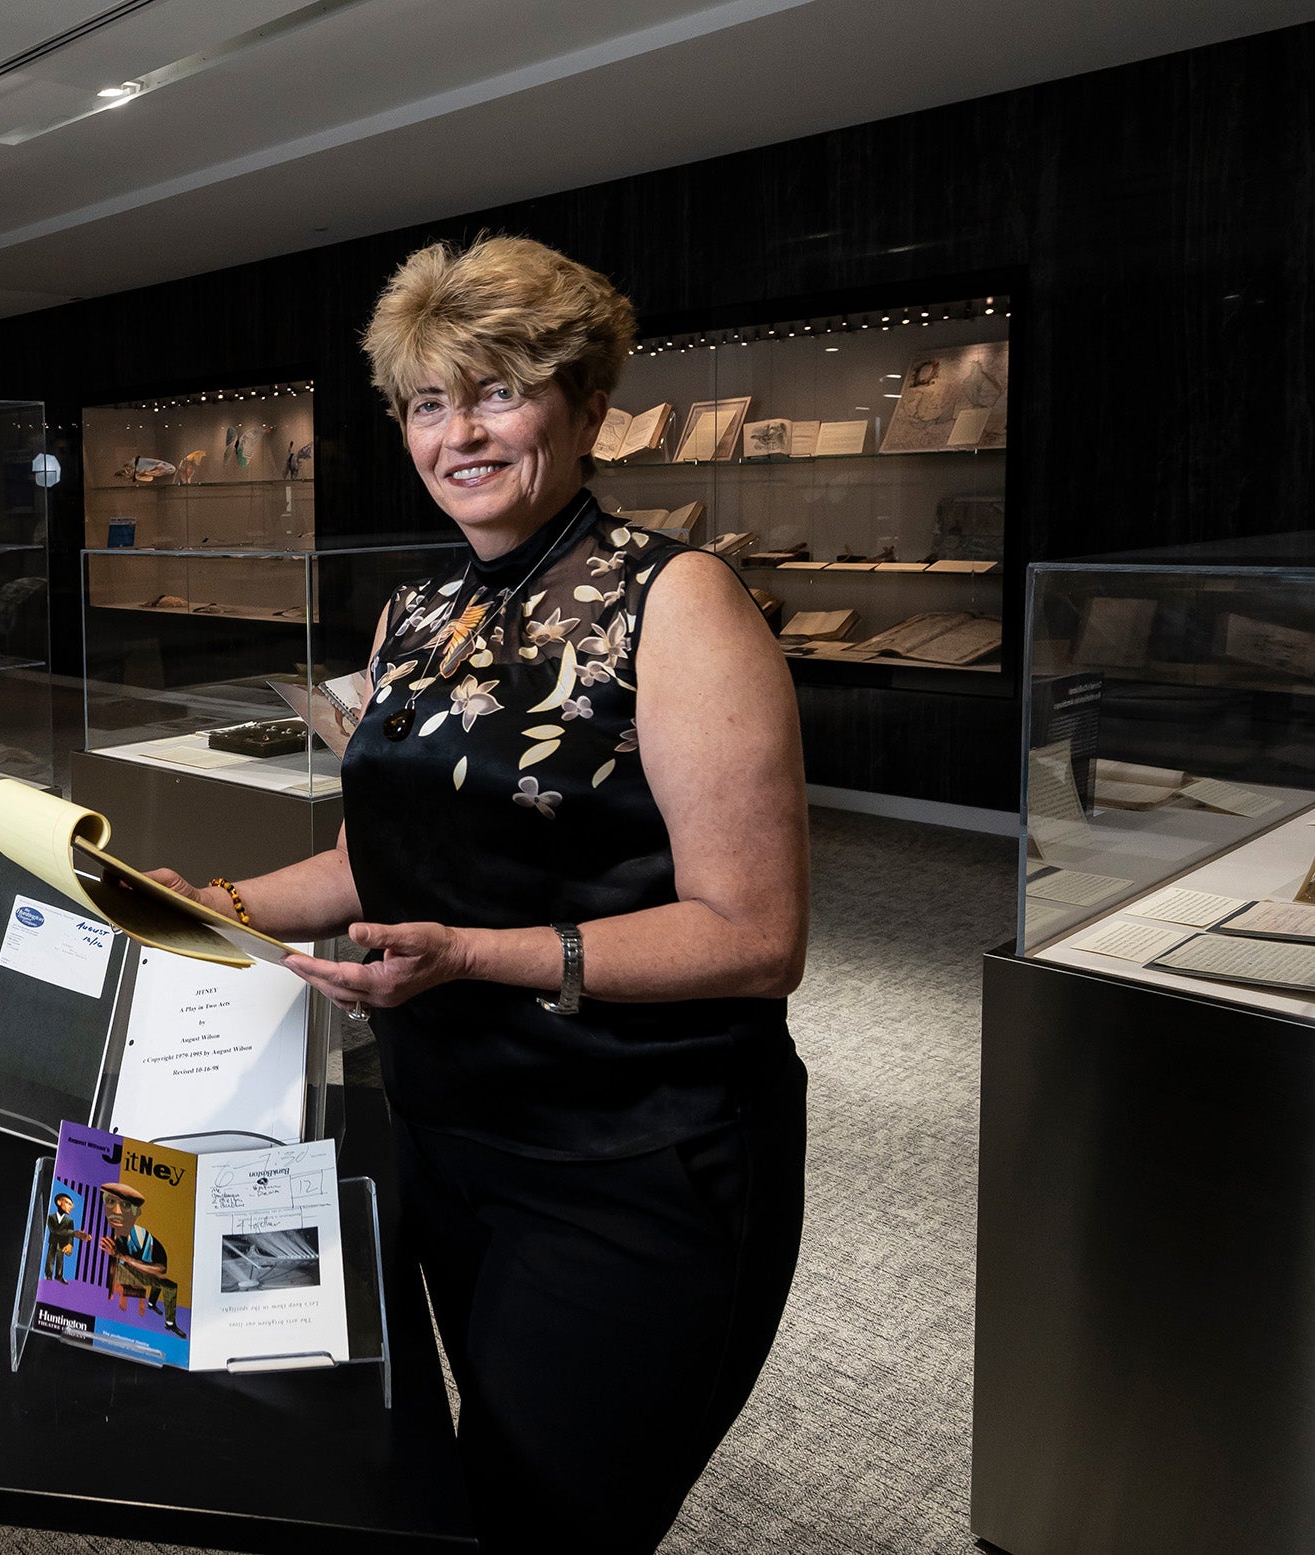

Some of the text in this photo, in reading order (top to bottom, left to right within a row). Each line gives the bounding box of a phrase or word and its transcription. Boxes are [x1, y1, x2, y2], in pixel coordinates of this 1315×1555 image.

[195, 987, 219, 996] JITNEY
[181, 1036, 200, 1044] August
[147, 1054, 174, 1063] Copyright
[173, 1068, 195, 1076] Revised
[68, 1137, 110, 1152] August Wilson's
[102, 1143, 186, 1187] JitNey
[249, 1168, 291, 1178] BankBoston
[299, 1180, 319, 1194] 12
[38, 1308, 87, 1331] Huntington
[37, 1320, 61, 1332] THEATRE
